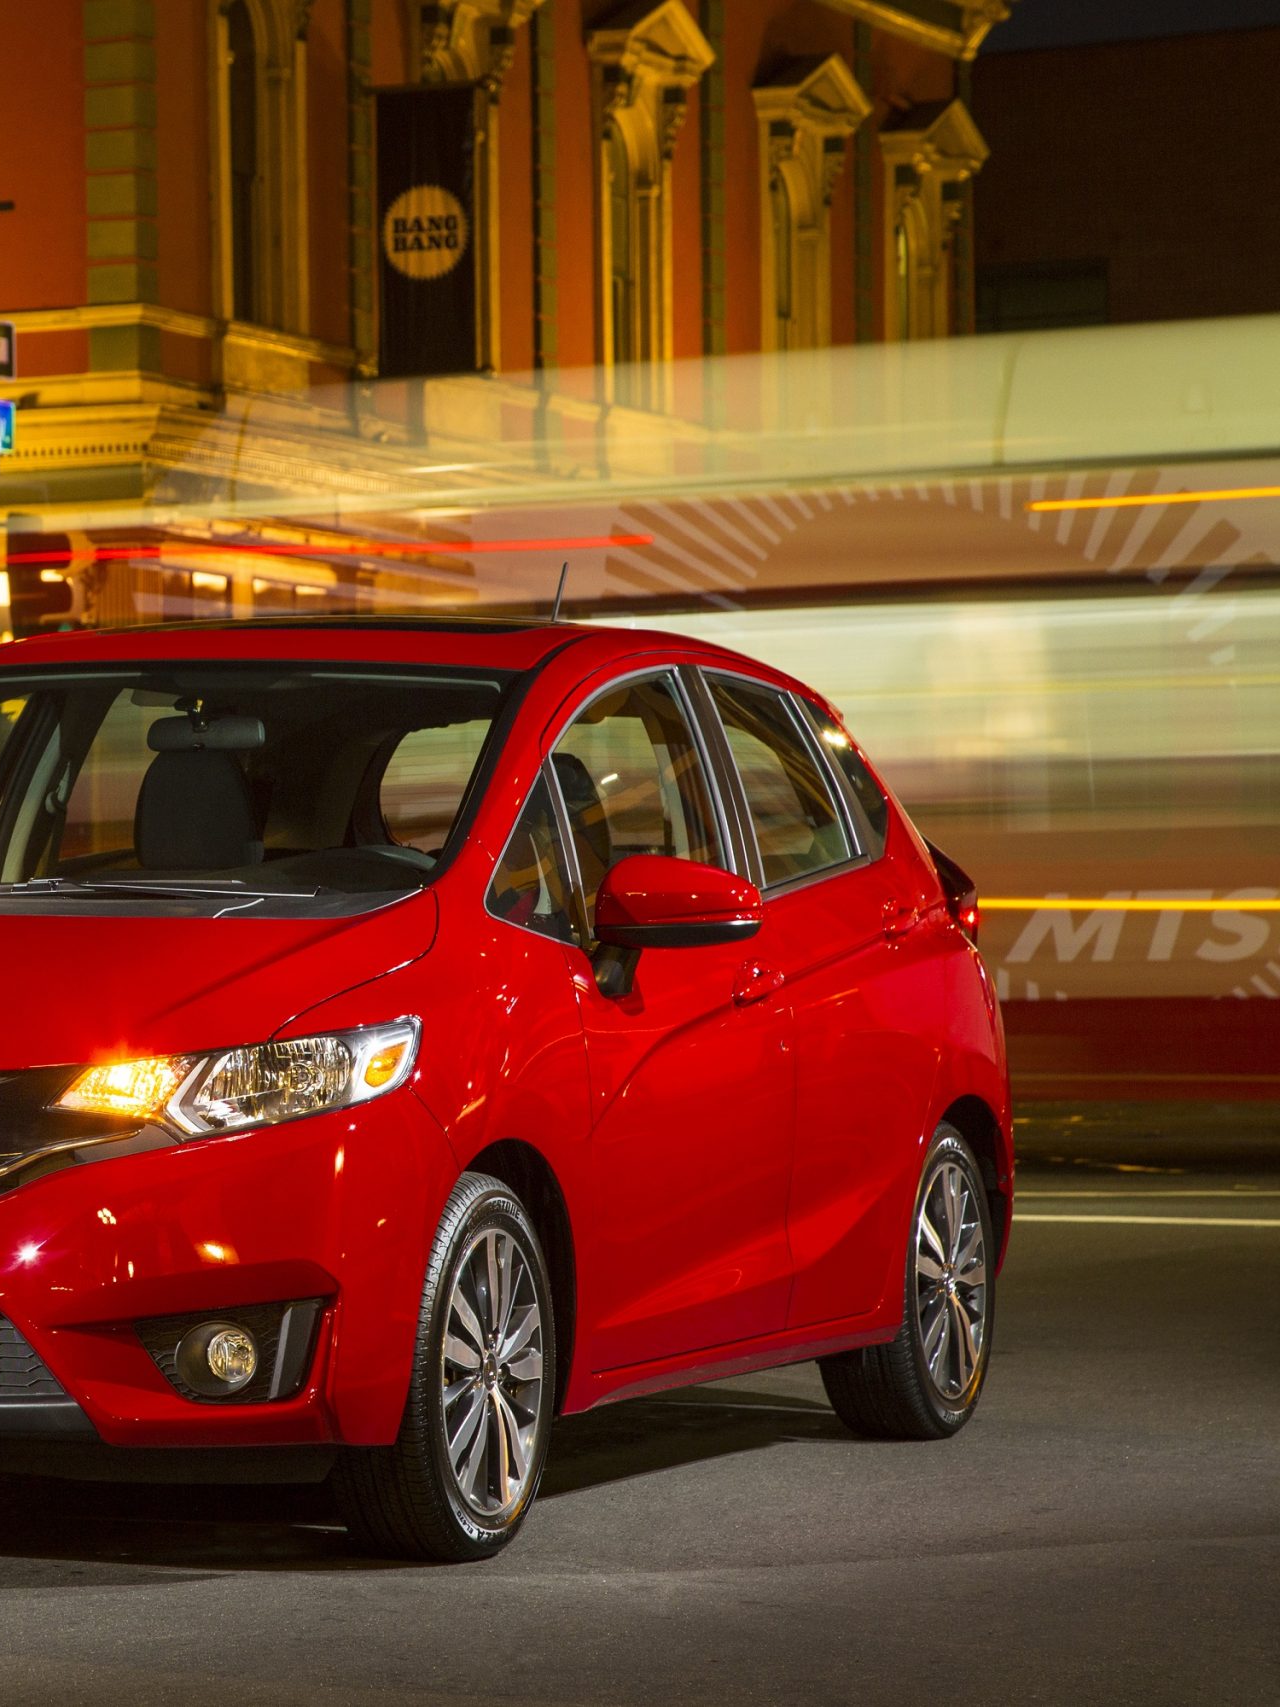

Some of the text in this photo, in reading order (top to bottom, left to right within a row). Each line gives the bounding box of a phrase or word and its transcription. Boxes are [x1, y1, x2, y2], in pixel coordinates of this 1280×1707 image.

[394, 215, 457, 233] BANG
[394, 235, 458, 253] BANG
[1005, 887, 1280, 962] MTS
